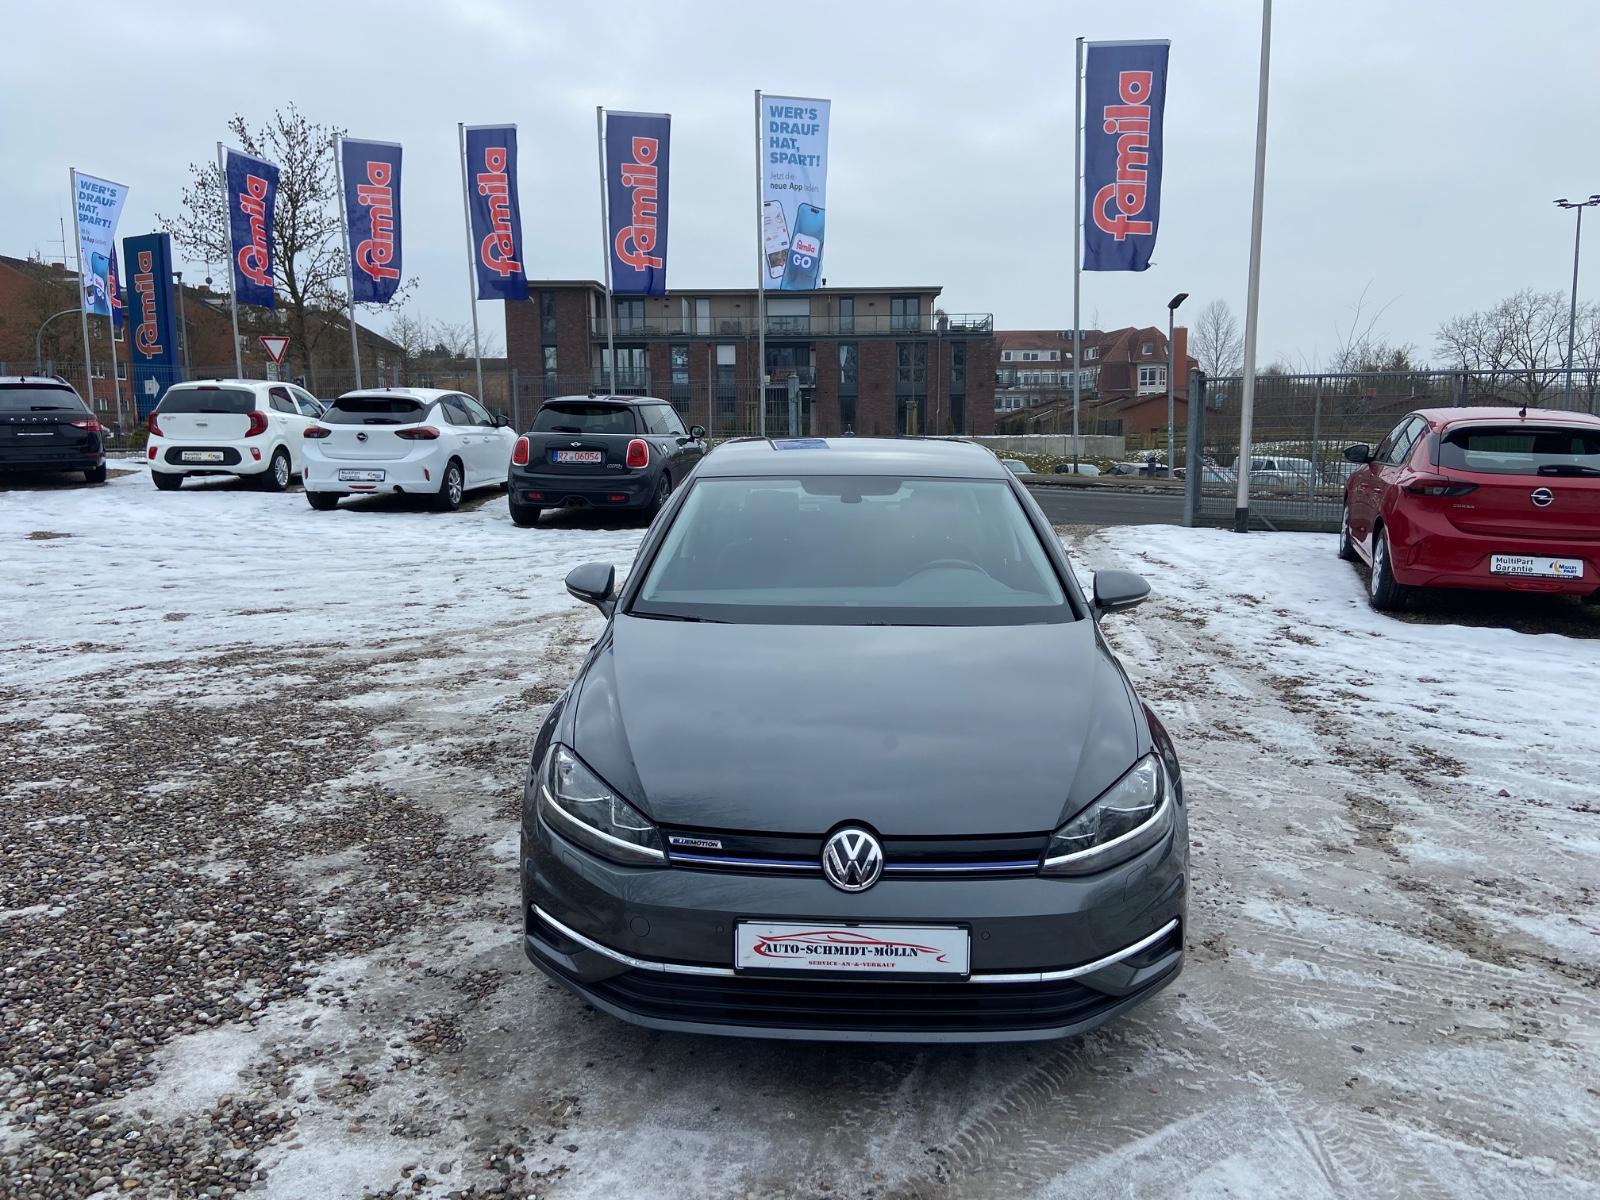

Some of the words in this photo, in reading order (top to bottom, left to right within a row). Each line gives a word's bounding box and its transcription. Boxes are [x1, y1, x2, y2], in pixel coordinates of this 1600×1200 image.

[769, 105, 818, 121] WER'S
[769, 121, 820, 136] DRAUF
[769, 136, 800, 153] HAT,
[769, 151, 820, 167] SPART!
[1092, 70, 1154, 241] famila
[80, 180, 117, 197] WER'S
[789, 182, 803, 192] App
[78, 191, 117, 208] DRAUF
[615, 136, 663, 272] famila
[78, 202, 99, 216] HAT,
[477, 146, 522, 277] famila
[78, 213, 112, 229] SPART!
[356, 160, 401, 282] famila
[237, 174, 274, 287] famila
[793, 254, 812, 269] GO
[135, 250, 163, 359] famila
[1495, 563, 1534, 573] Garantie
[1496, 557, 1534, 566] MultiPart
[672, 838, 719, 848] BLUEMOTION
[763, 943, 918, 958] AUTO-SCHMIDT-MÖLLN
